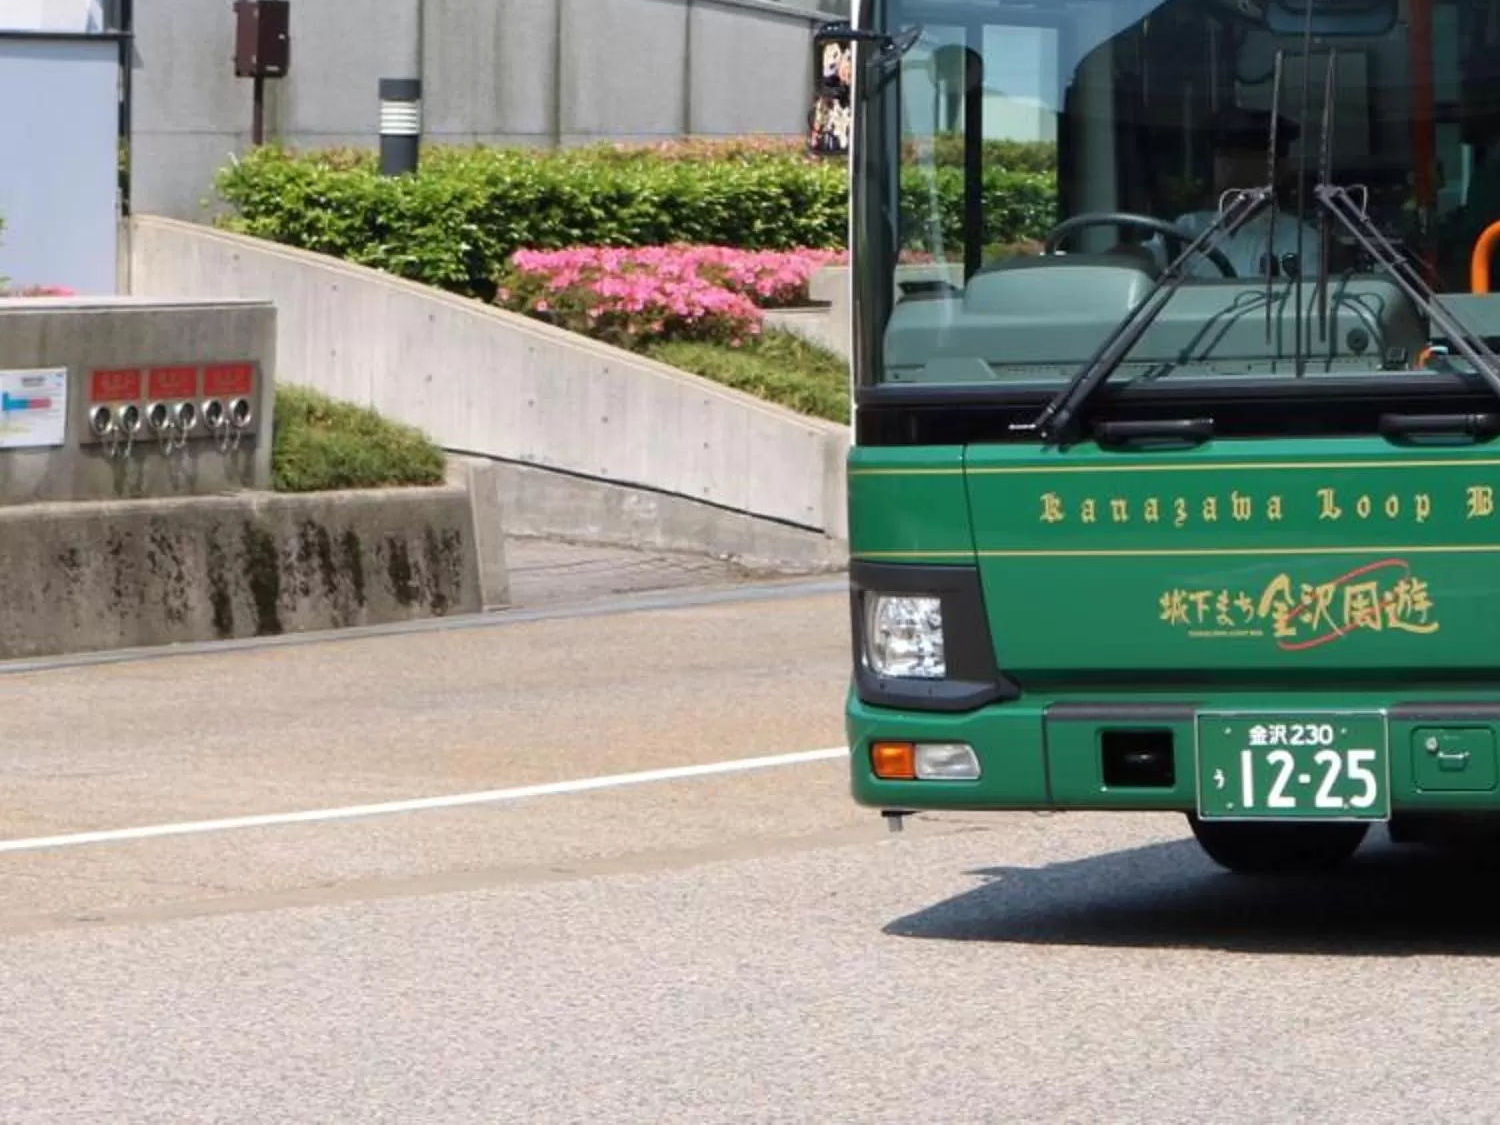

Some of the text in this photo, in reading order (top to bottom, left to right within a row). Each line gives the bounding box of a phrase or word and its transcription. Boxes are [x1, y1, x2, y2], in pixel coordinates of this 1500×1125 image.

[1039, 490, 1282, 527] Kanazawa
[1316, 487, 1431, 523] Loop
[1159, 574, 1439, 637] 城下まち金沢周遊
[1241, 749, 1377, 808] 12-25
